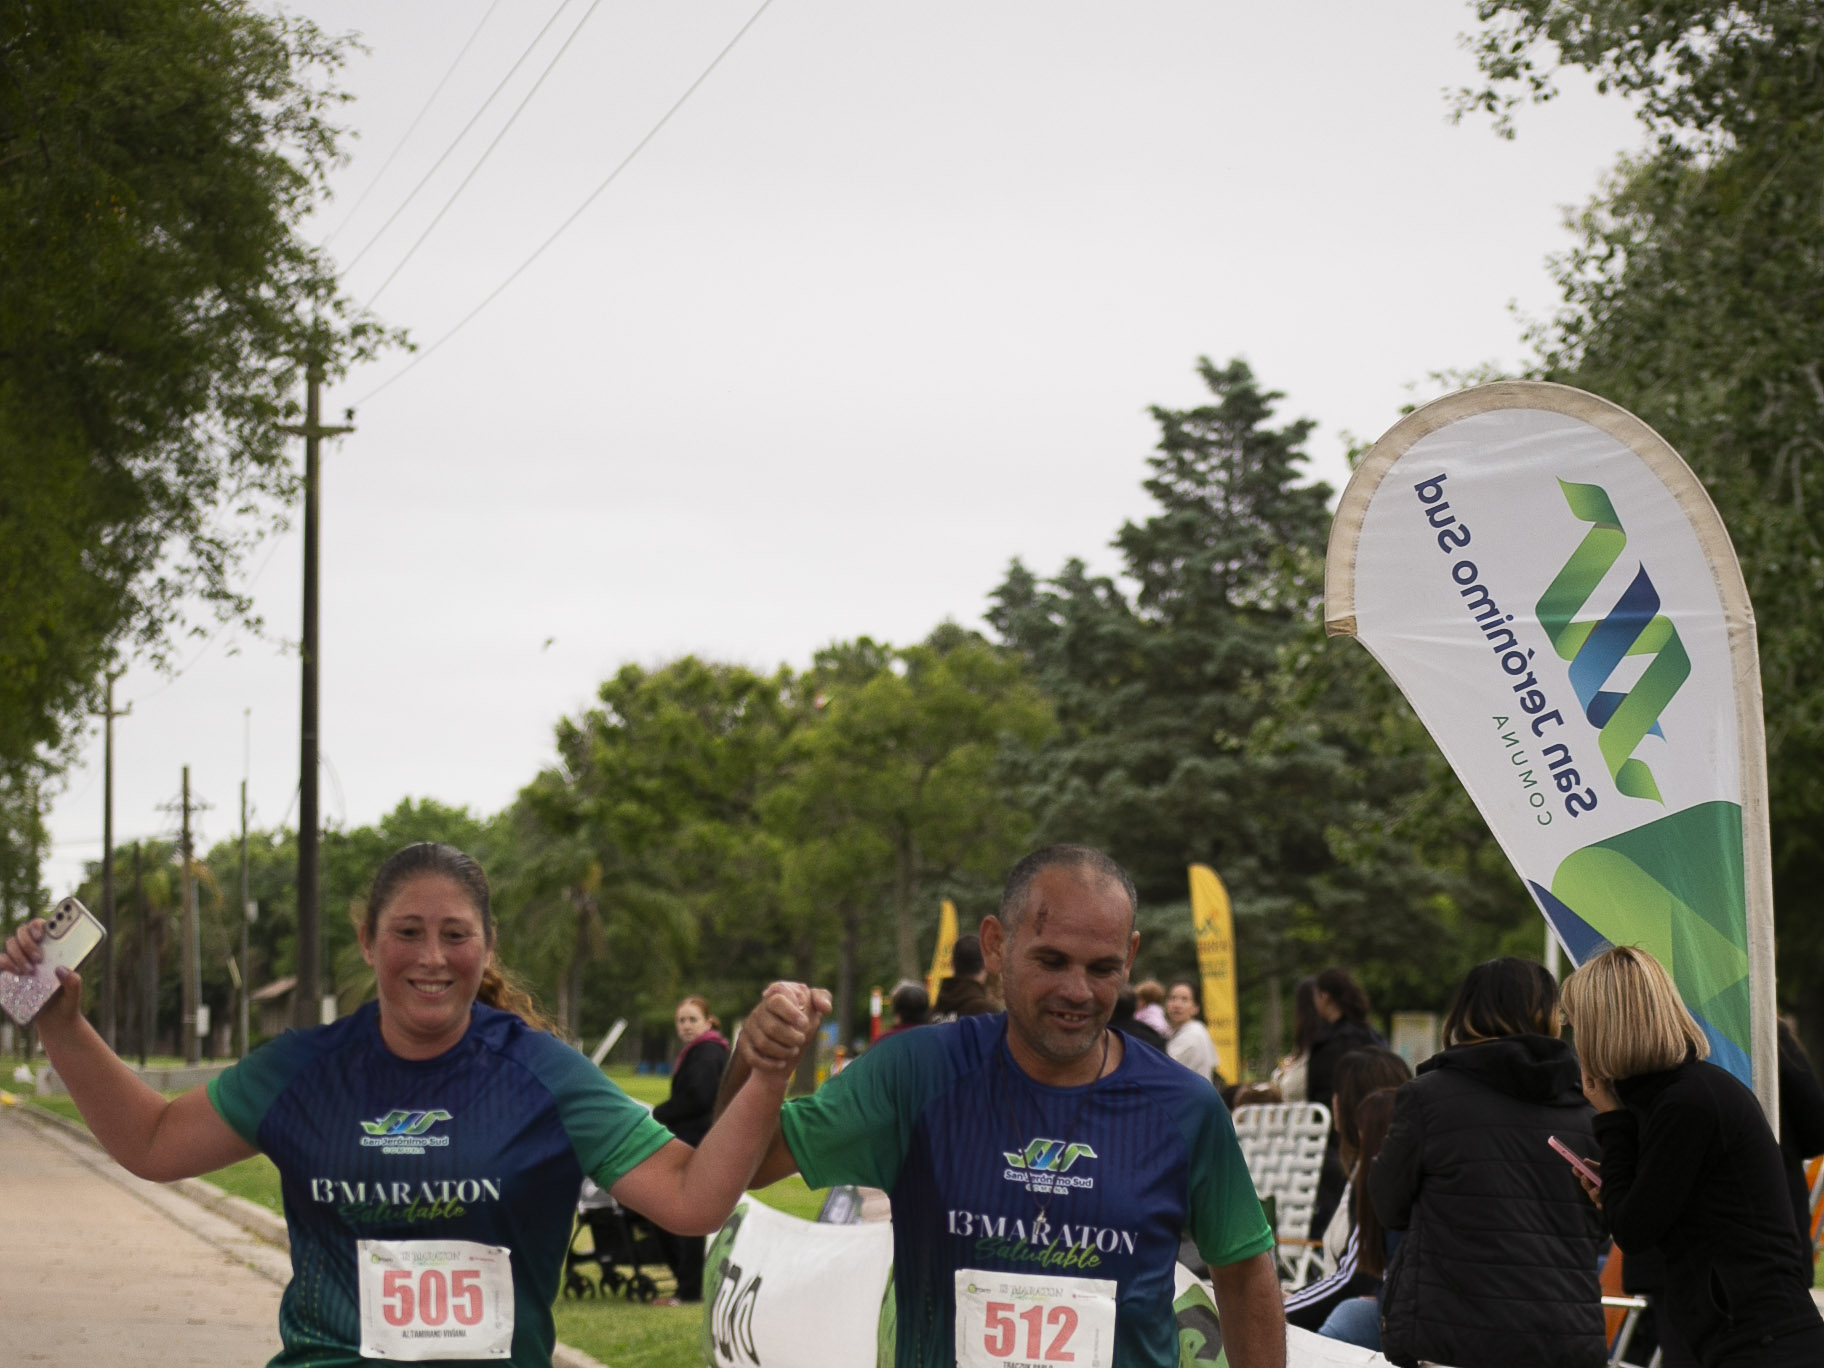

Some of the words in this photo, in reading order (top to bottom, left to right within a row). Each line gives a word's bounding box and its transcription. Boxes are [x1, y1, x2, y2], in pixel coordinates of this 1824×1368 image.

[428, 1135, 449, 1146] Sud
[1004, 1169, 1024, 1181] San
[1072, 1176, 1094, 1189] Sud
[338, 1197, 466, 1224] Saludable
[980, 1213, 1139, 1256] MARATON
[974, 1235, 1101, 1268] Saludable
[383, 1269, 484, 1326] 505
[984, 1301, 1079, 1362] 512
